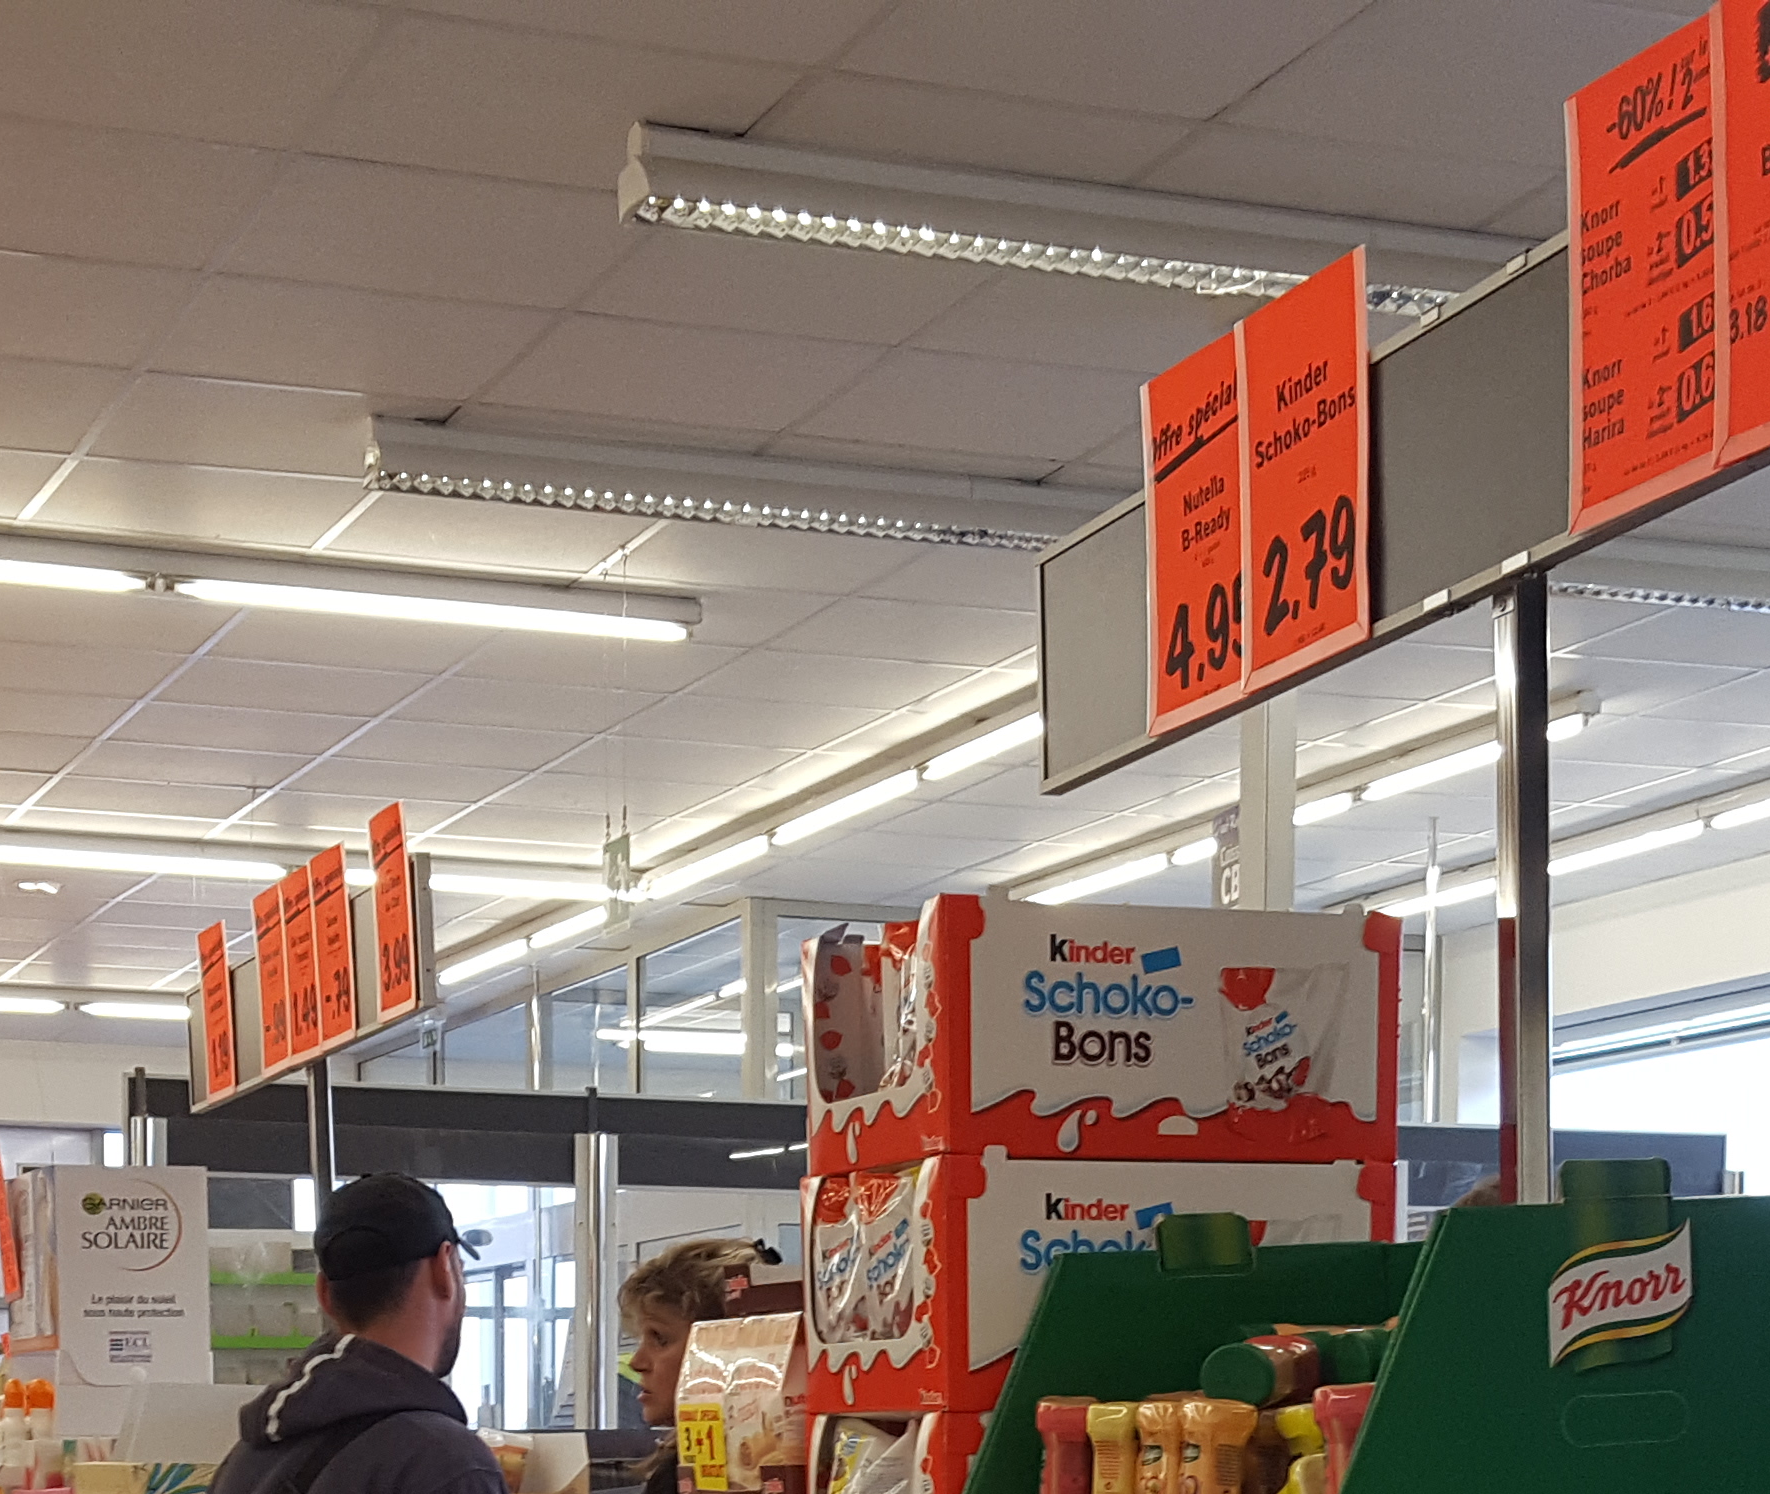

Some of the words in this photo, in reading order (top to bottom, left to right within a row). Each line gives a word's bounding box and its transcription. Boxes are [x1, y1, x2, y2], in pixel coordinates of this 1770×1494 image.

[1187, 366, 1238, 440] spécial
[1275, 360, 1329, 413] Kinder
[1254, 385, 1357, 469] Schoko-Bons
[1582, 418, 1625, 450] Harira
[1182, 474, 1225, 517] Nutella
[1181, 505, 1232, 553] B-Ready
[1262, 494, 1356, 637] 2.79
[1024, 969, 1195, 1018] Schoko-
[1053, 1019, 1153, 1065] Bons
[1254, 1043, 1291, 1069] Bons
[81, 1196, 169, 1213] GARNIER
[105, 1215, 171, 1231] AMBRE
[1045, 1193, 1129, 1222] kinder
[81, 1231, 171, 1250] SOLAIRE
[1553, 1261, 1687, 1331] Knorr
